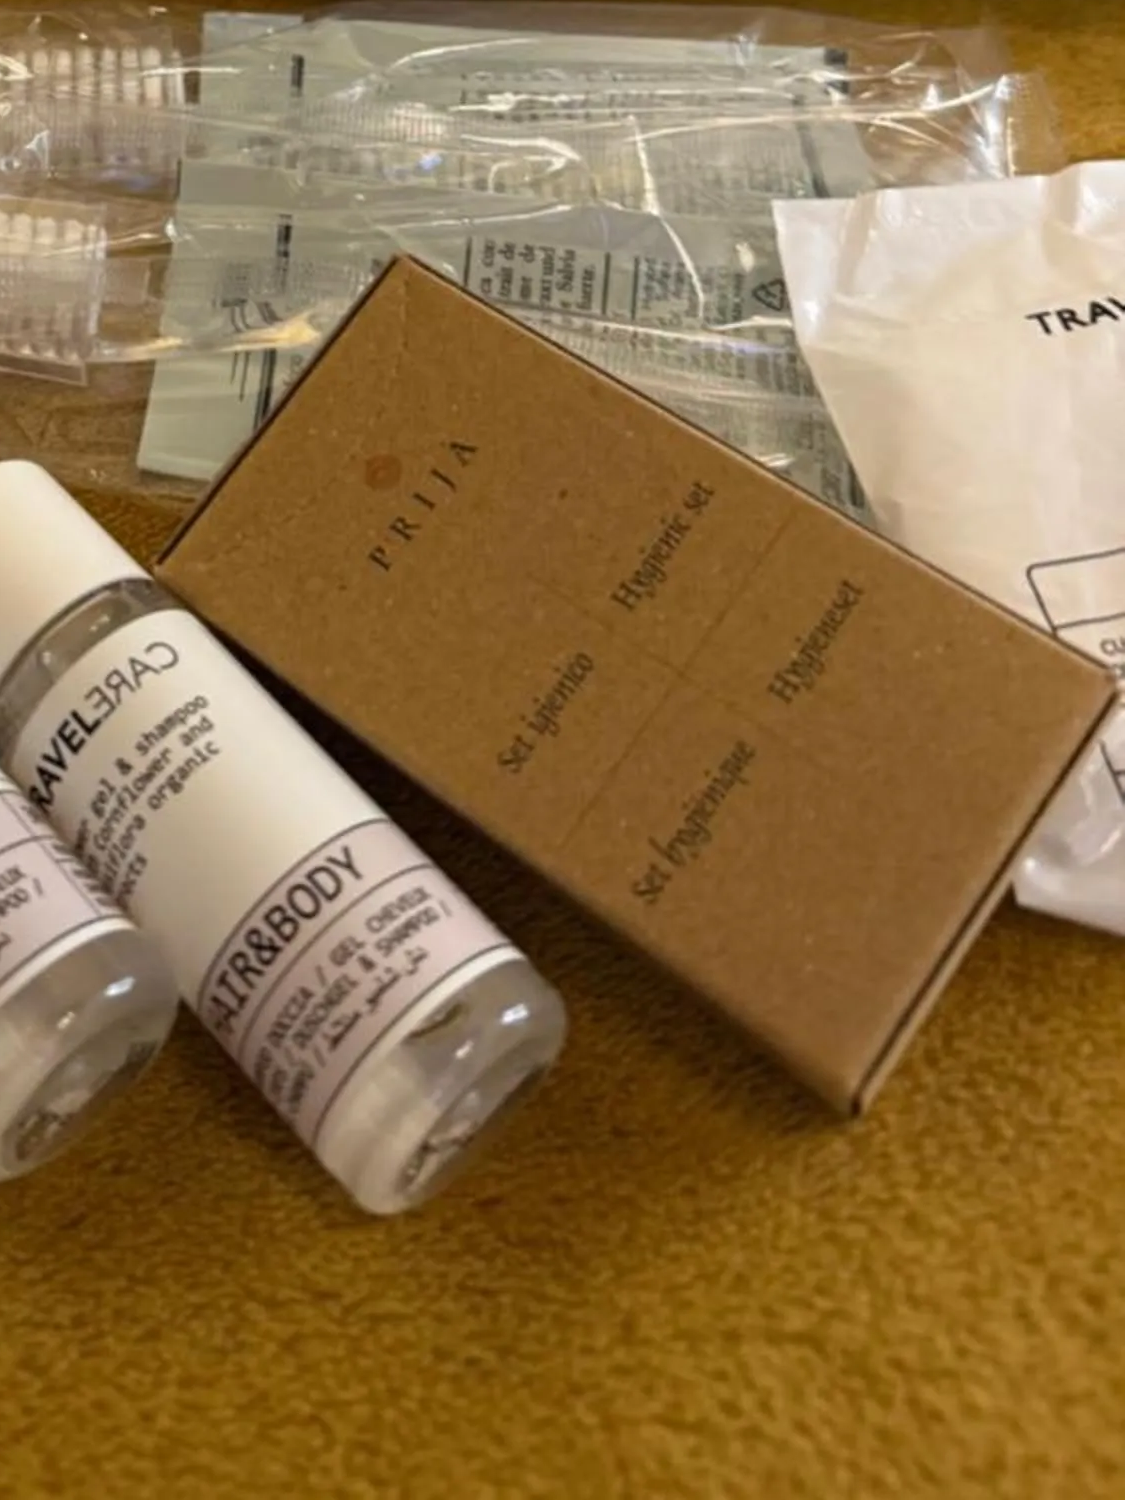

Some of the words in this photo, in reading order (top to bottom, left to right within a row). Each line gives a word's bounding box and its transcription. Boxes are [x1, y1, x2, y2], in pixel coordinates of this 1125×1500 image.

[610, 513, 692, 612] Hygienic
[683, 479, 716, 516] set
[767, 579, 866, 704] Hygieneset
[28, 709, 103, 814] RAVEL
[91, 777, 117, 819] gel
[113, 757, 134, 777] &
[134, 694, 209, 757] shampoo
[179, 716, 215, 747] and
[496, 733, 535, 774] Set
[519, 651, 595, 738] igienico
[146, 740, 221, 812] organic
[631, 862, 672, 906] Set
